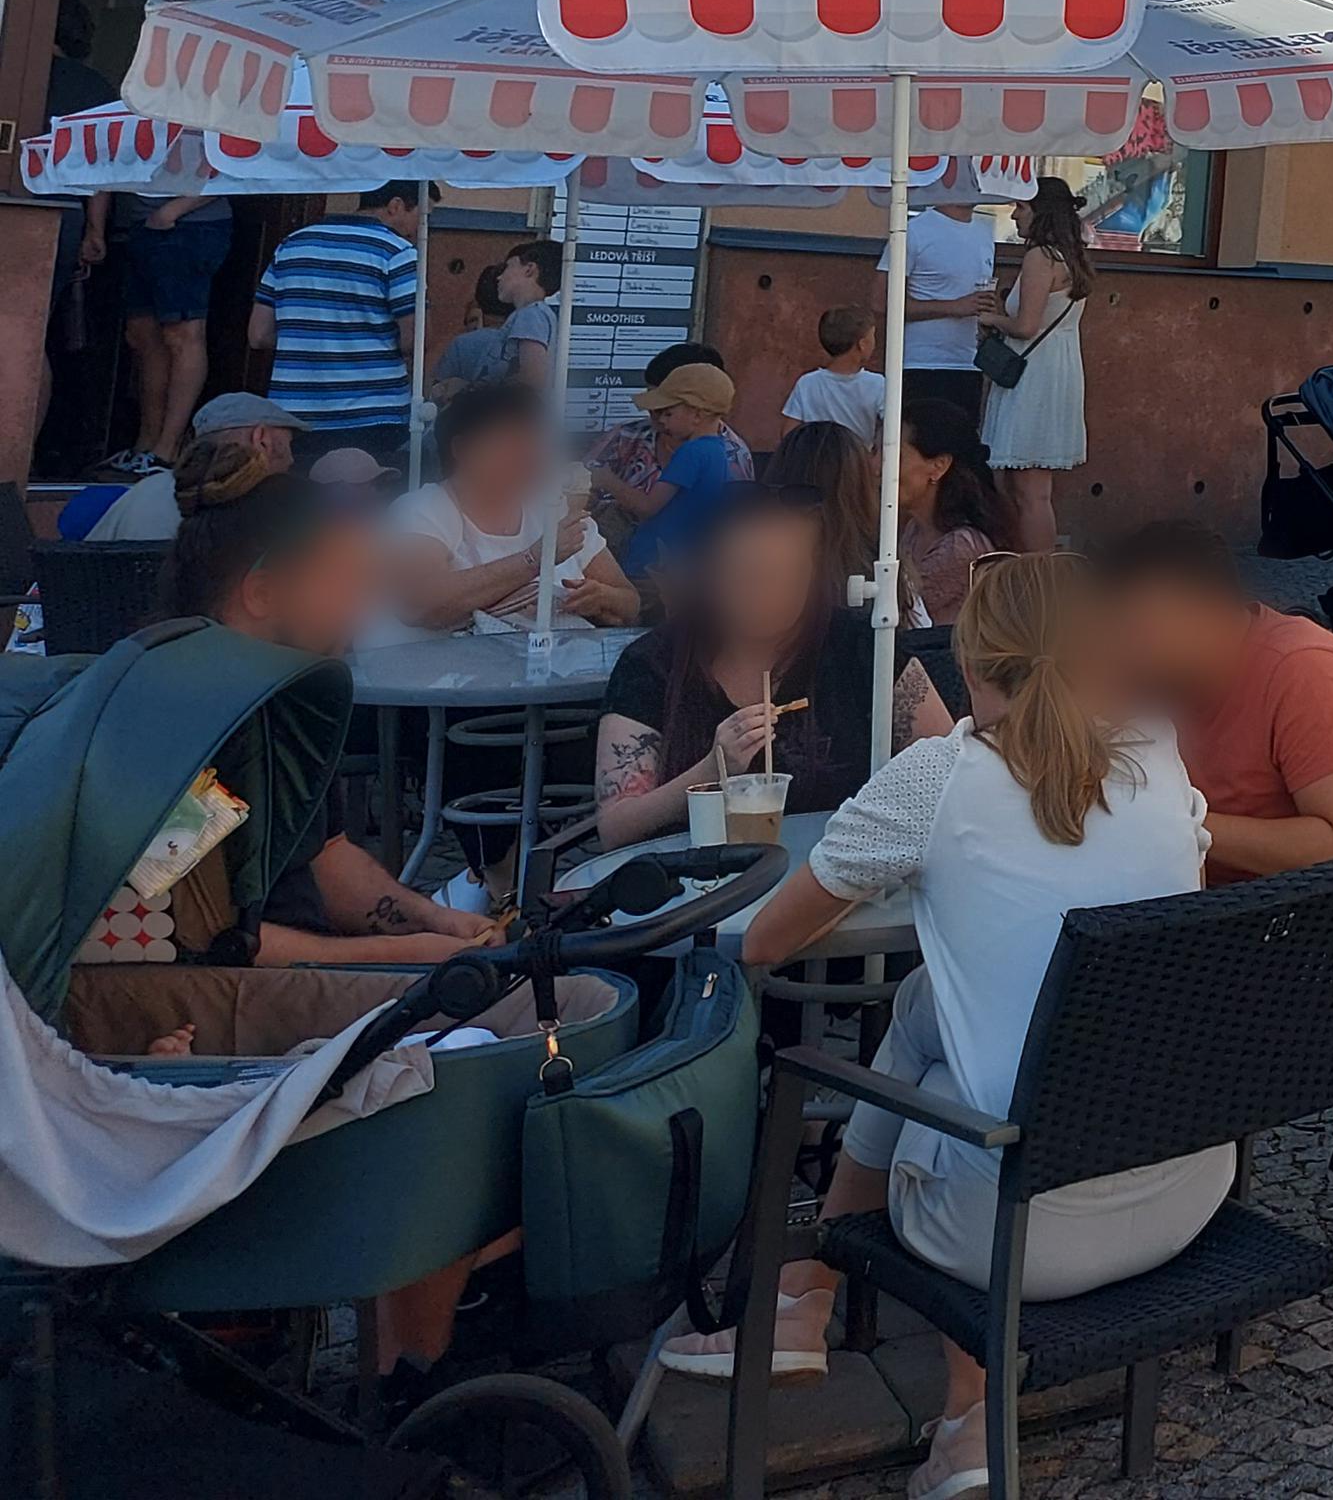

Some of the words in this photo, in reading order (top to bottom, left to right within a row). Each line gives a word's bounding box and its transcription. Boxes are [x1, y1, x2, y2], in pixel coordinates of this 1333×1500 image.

[590, 250, 629, 261] LEDOVÁ
[586, 313, 646, 324] SMOOTHIES
[594, 373, 623, 385] KÁVA
